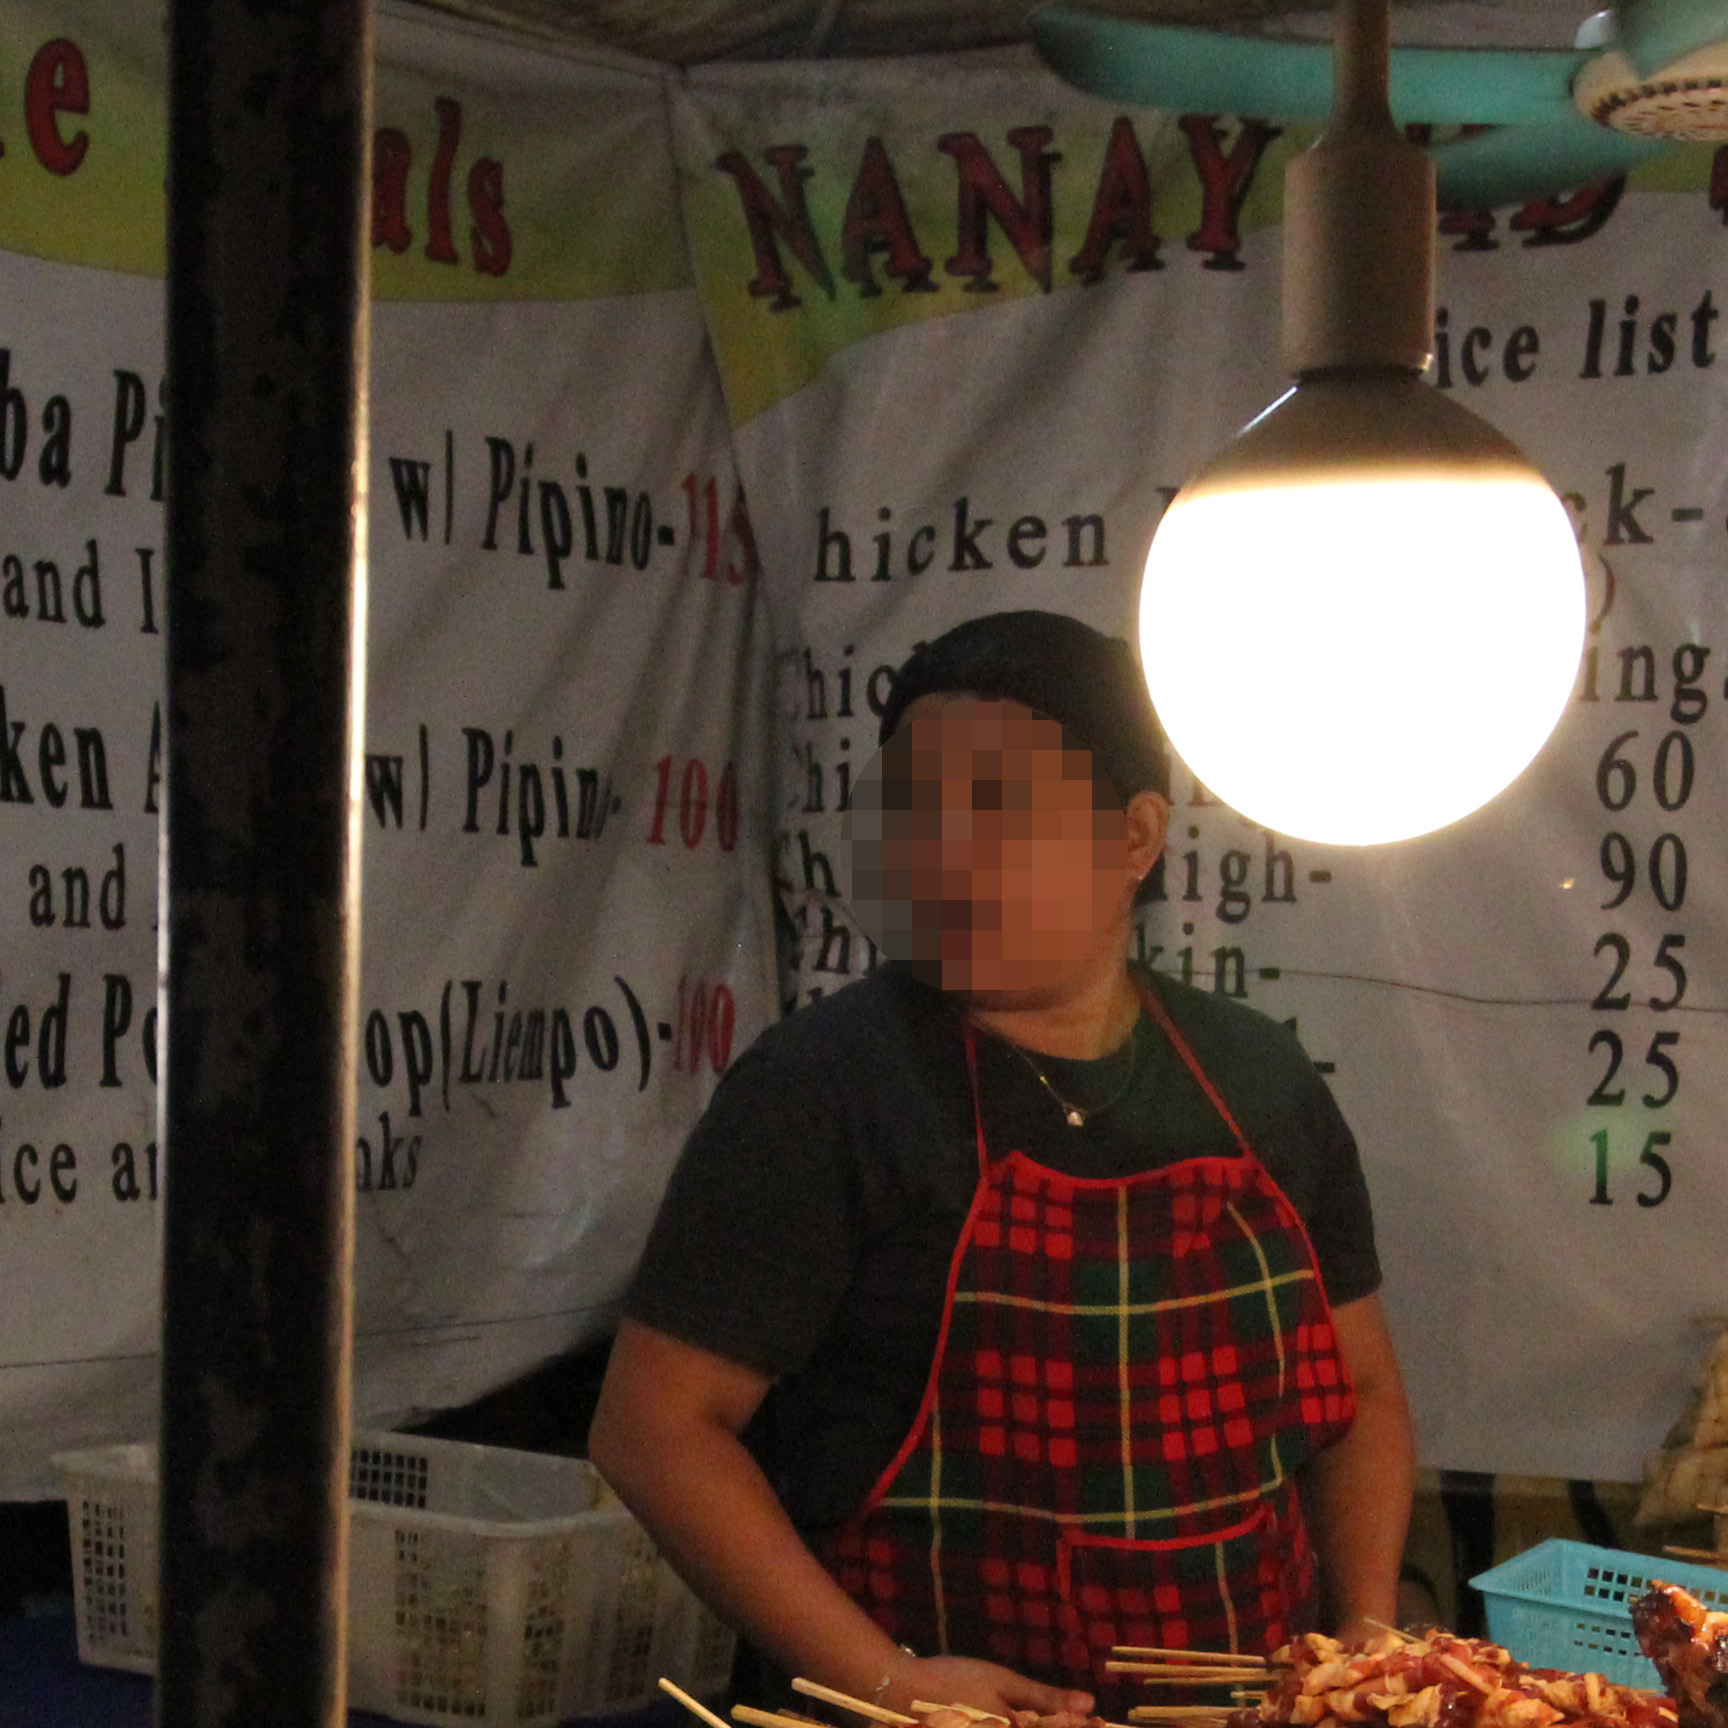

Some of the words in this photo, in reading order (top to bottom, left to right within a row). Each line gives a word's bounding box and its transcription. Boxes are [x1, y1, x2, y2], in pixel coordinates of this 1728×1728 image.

[715, 113, 1282, 312] NANAY
[1579, 289, 1719, 381] list
[2, 539, 106, 628] and
[647, 754, 741, 853] 100
[1595, 730, 1696, 813] 60
[27, 843, 127, 931] and
[1154, 824, 1332, 924] igh-
[1598, 831, 1689, 912] 90
[1589, 932, 1689, 1012] 25
[1586, 1029, 1682, 1110] 25
[1588, 1128, 1674, 1208] 15
